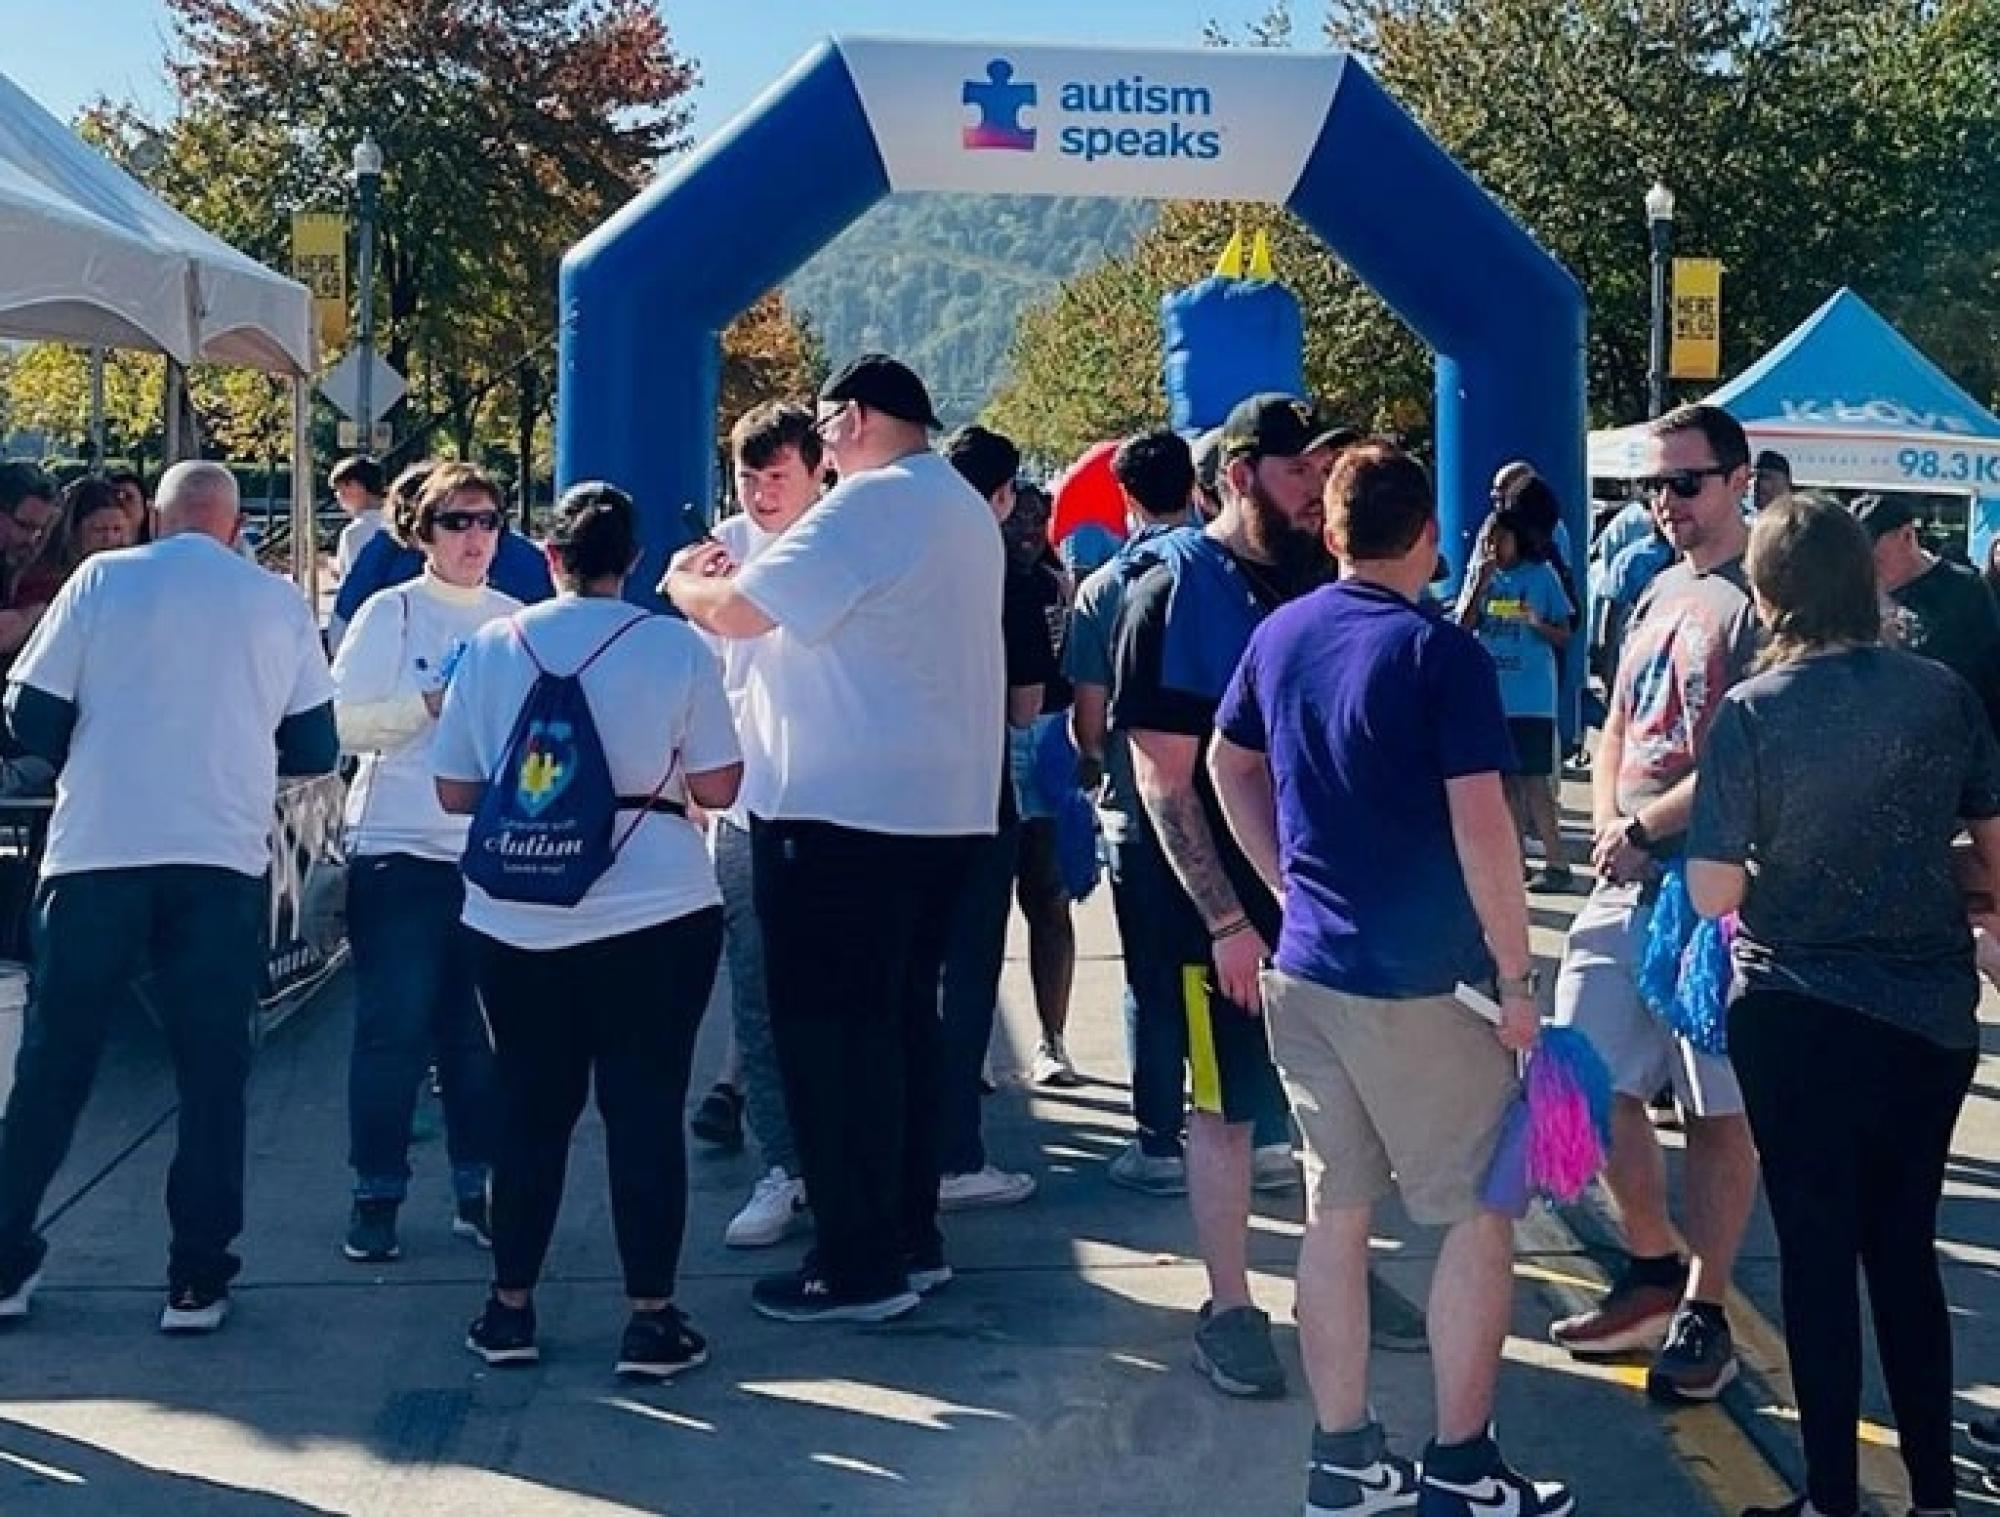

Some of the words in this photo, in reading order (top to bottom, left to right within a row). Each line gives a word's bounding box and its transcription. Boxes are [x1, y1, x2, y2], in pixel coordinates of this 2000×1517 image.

[1060, 75, 1211, 115] autism
[1060, 122, 1221, 161] speaks
[1898, 448, 1969, 480] 98.3
[483, 831, 584, 856] Autism
